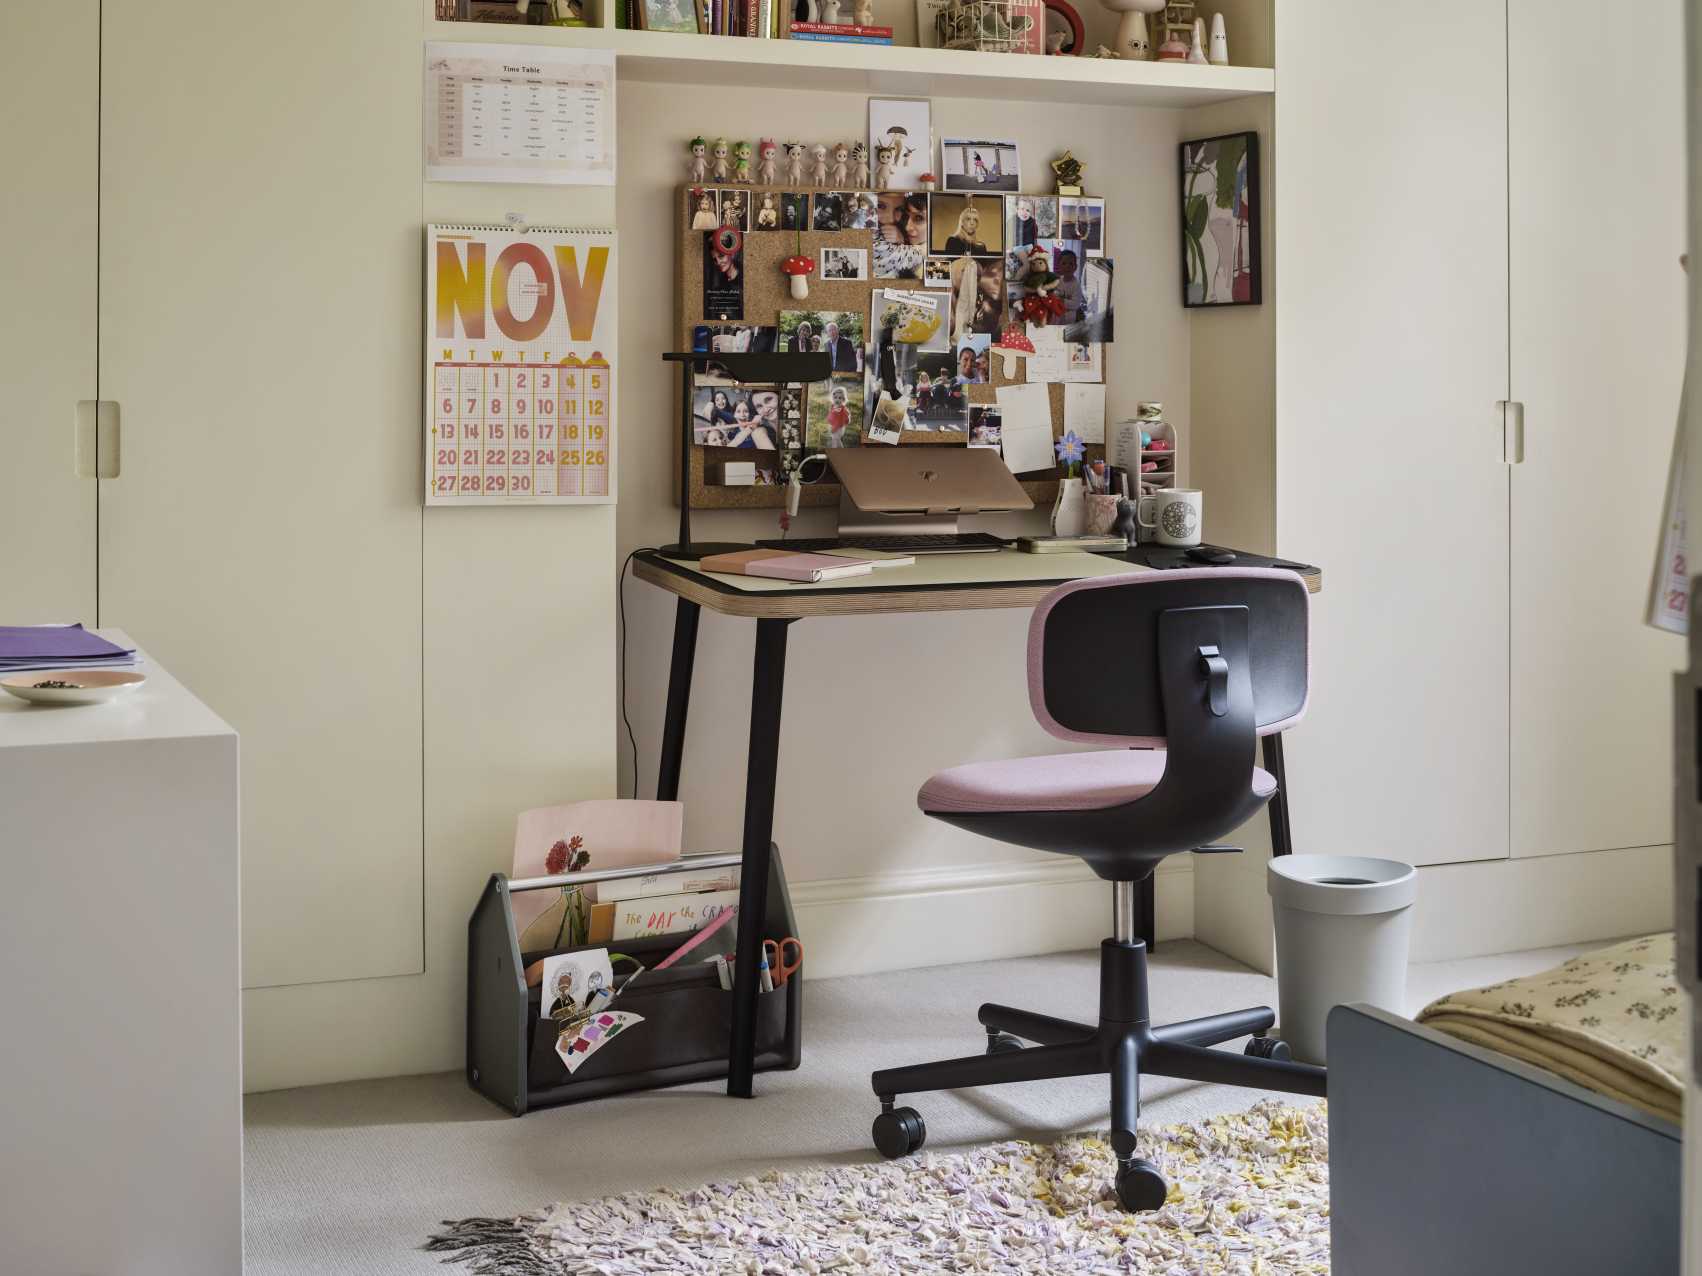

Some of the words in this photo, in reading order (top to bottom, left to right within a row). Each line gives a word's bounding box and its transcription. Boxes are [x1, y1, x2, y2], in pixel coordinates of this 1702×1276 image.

[503, 65, 520, 73] Time
[522, 66, 540, 74] Table
[436, 241, 610, 341] NOV
[443, 350, 453, 361] M
[469, 350, 476, 361] T
[492, 351, 503, 362] W
[518, 351, 526, 362] T
[543, 352, 551, 362] F
[494, 373, 499, 388] 1
[517, 373, 527, 388] 2
[541, 373, 550, 388] 3
[566, 374, 576, 389] 4
[591, 374, 601, 389] 5
[443, 399, 452, 414] 6
[467, 399, 476, 414] 7
[491, 399, 501, 414] 8
[516, 399, 526, 414] 9
[538, 400, 554, 414] 10
[564, 400, 577, 414] 11
[589, 400, 603, 415] 12
[440, 424, 454, 439] 13
[464, 424, 479, 439] 14
[488, 424, 504, 439] 15
[513, 424, 529, 439] 16
[538, 424, 554, 439] 17
[563, 424, 578, 440] 18
[588, 425, 604, 440] 19
[438, 450, 457, 465] 20
[463, 450, 479, 465] 21
[486, 450, 506, 465] 22
[511, 450, 530, 465] 23
[536, 450, 555, 465] 24
[560, 450, 580, 465] 25
[585, 450, 605, 465] 26
[438, 476, 457, 491] 27
[461, 476, 481, 491] 28
[485, 476, 506, 491] 29
[511, 476, 530, 491] 30
